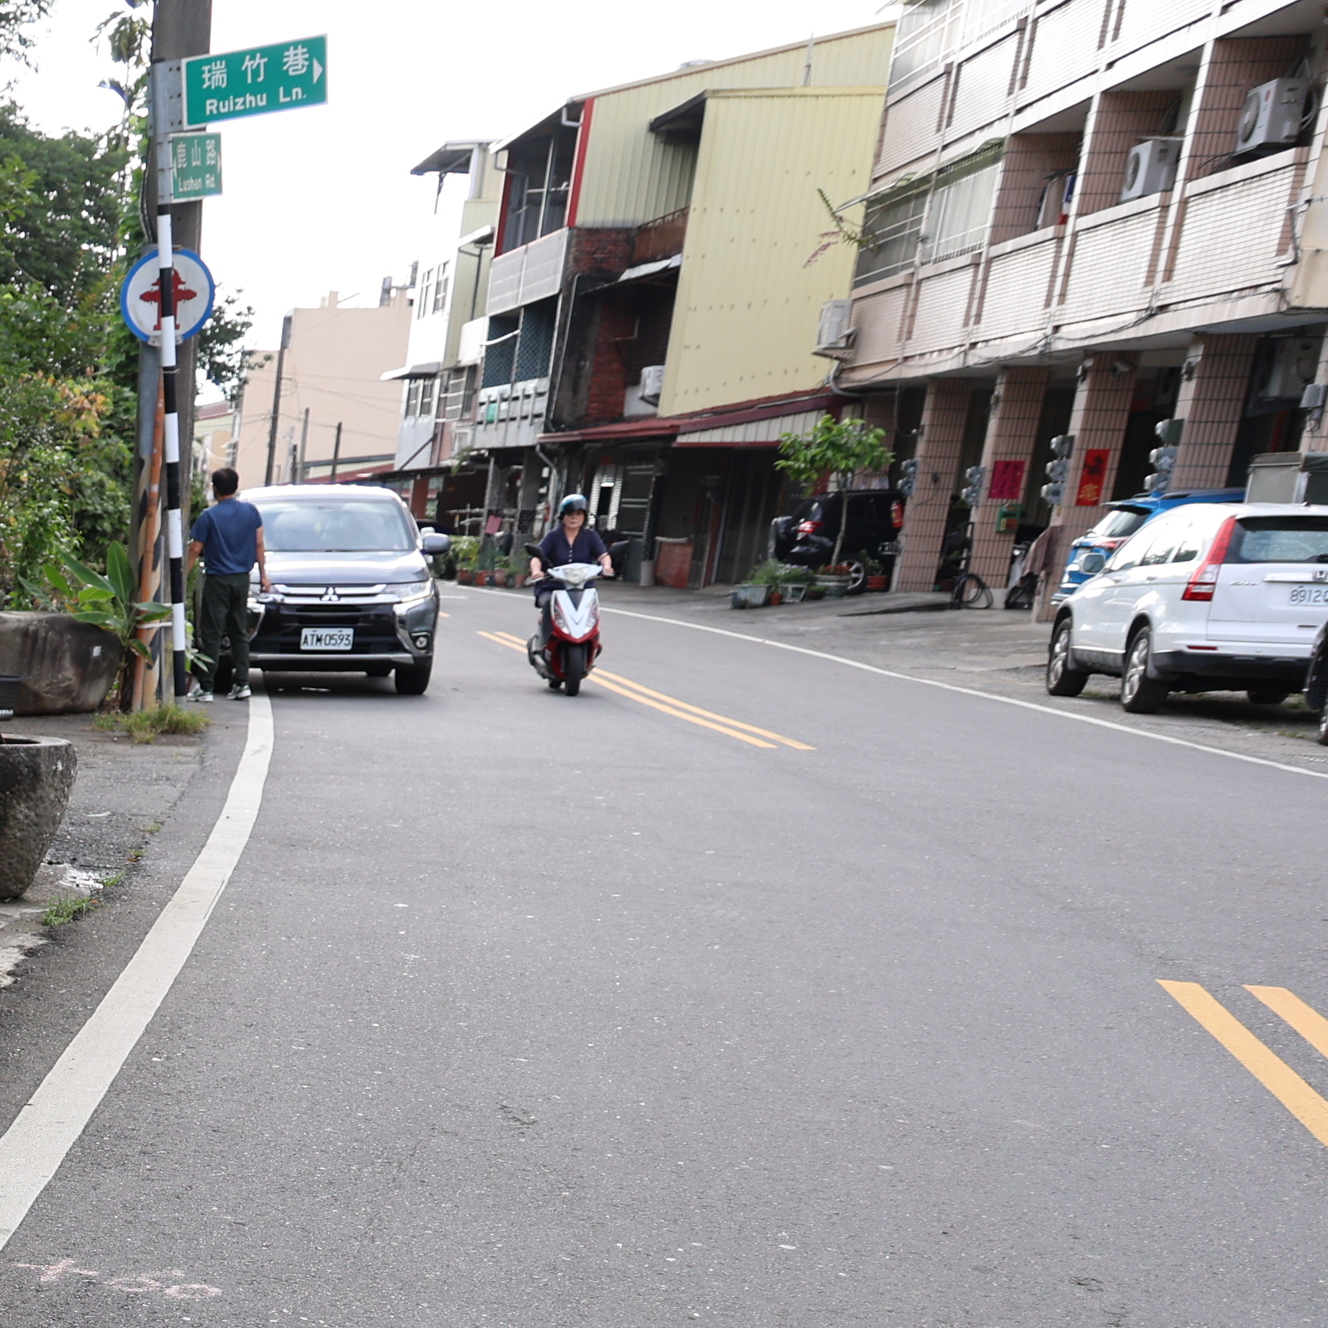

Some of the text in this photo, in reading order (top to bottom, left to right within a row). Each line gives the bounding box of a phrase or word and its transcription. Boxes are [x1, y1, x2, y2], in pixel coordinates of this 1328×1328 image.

[201, 45, 310, 90] 瑞竹巷
[205, 86, 307, 116] Ruizhu Ln.
[178, 176, 202, 192] Lushan
